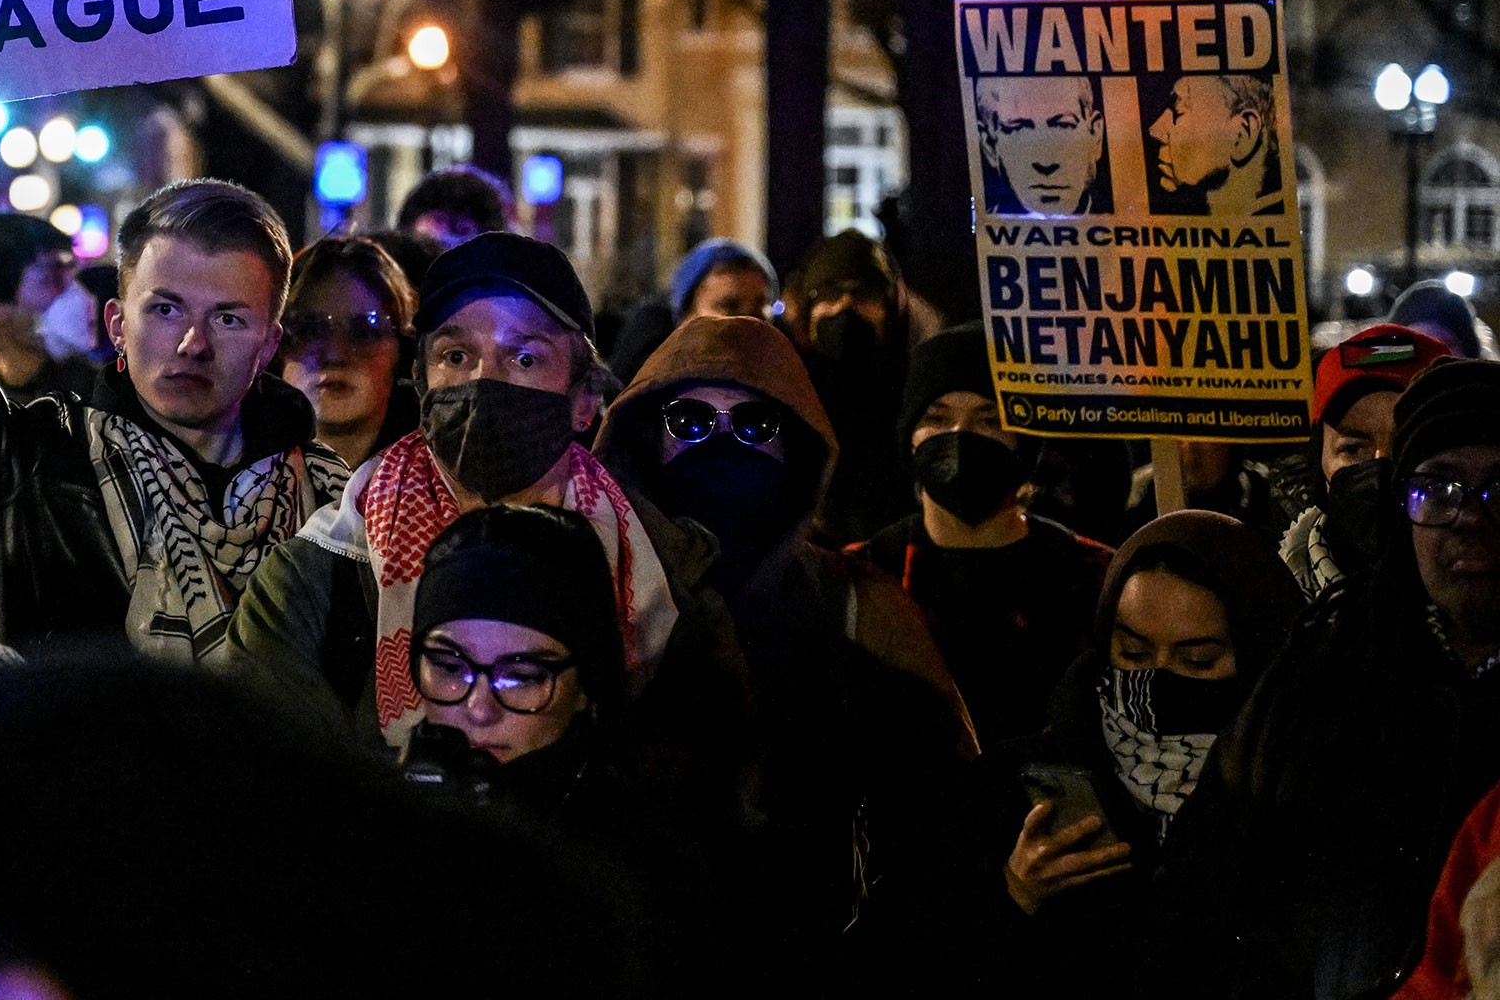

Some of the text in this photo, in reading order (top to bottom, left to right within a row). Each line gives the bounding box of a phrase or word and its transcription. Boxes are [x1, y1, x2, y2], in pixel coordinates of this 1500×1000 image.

[965, 3, 1273, 73] WANTED
[986, 226, 1291, 248] WAR CRIMINAL
[986, 255, 1297, 315] BENJAMIN
[991, 315, 1301, 370] NETANYAHU
[997, 371, 1303, 389] FOR CRIMES AGAINST HUMANITY
[1036, 404, 1076, 425] Party
[1080, 406, 1103, 422] for
[1106, 406, 1183, 424] Socialism
[1186, 410, 1216, 425] and
[1219, 410, 1303, 427] Liberation
